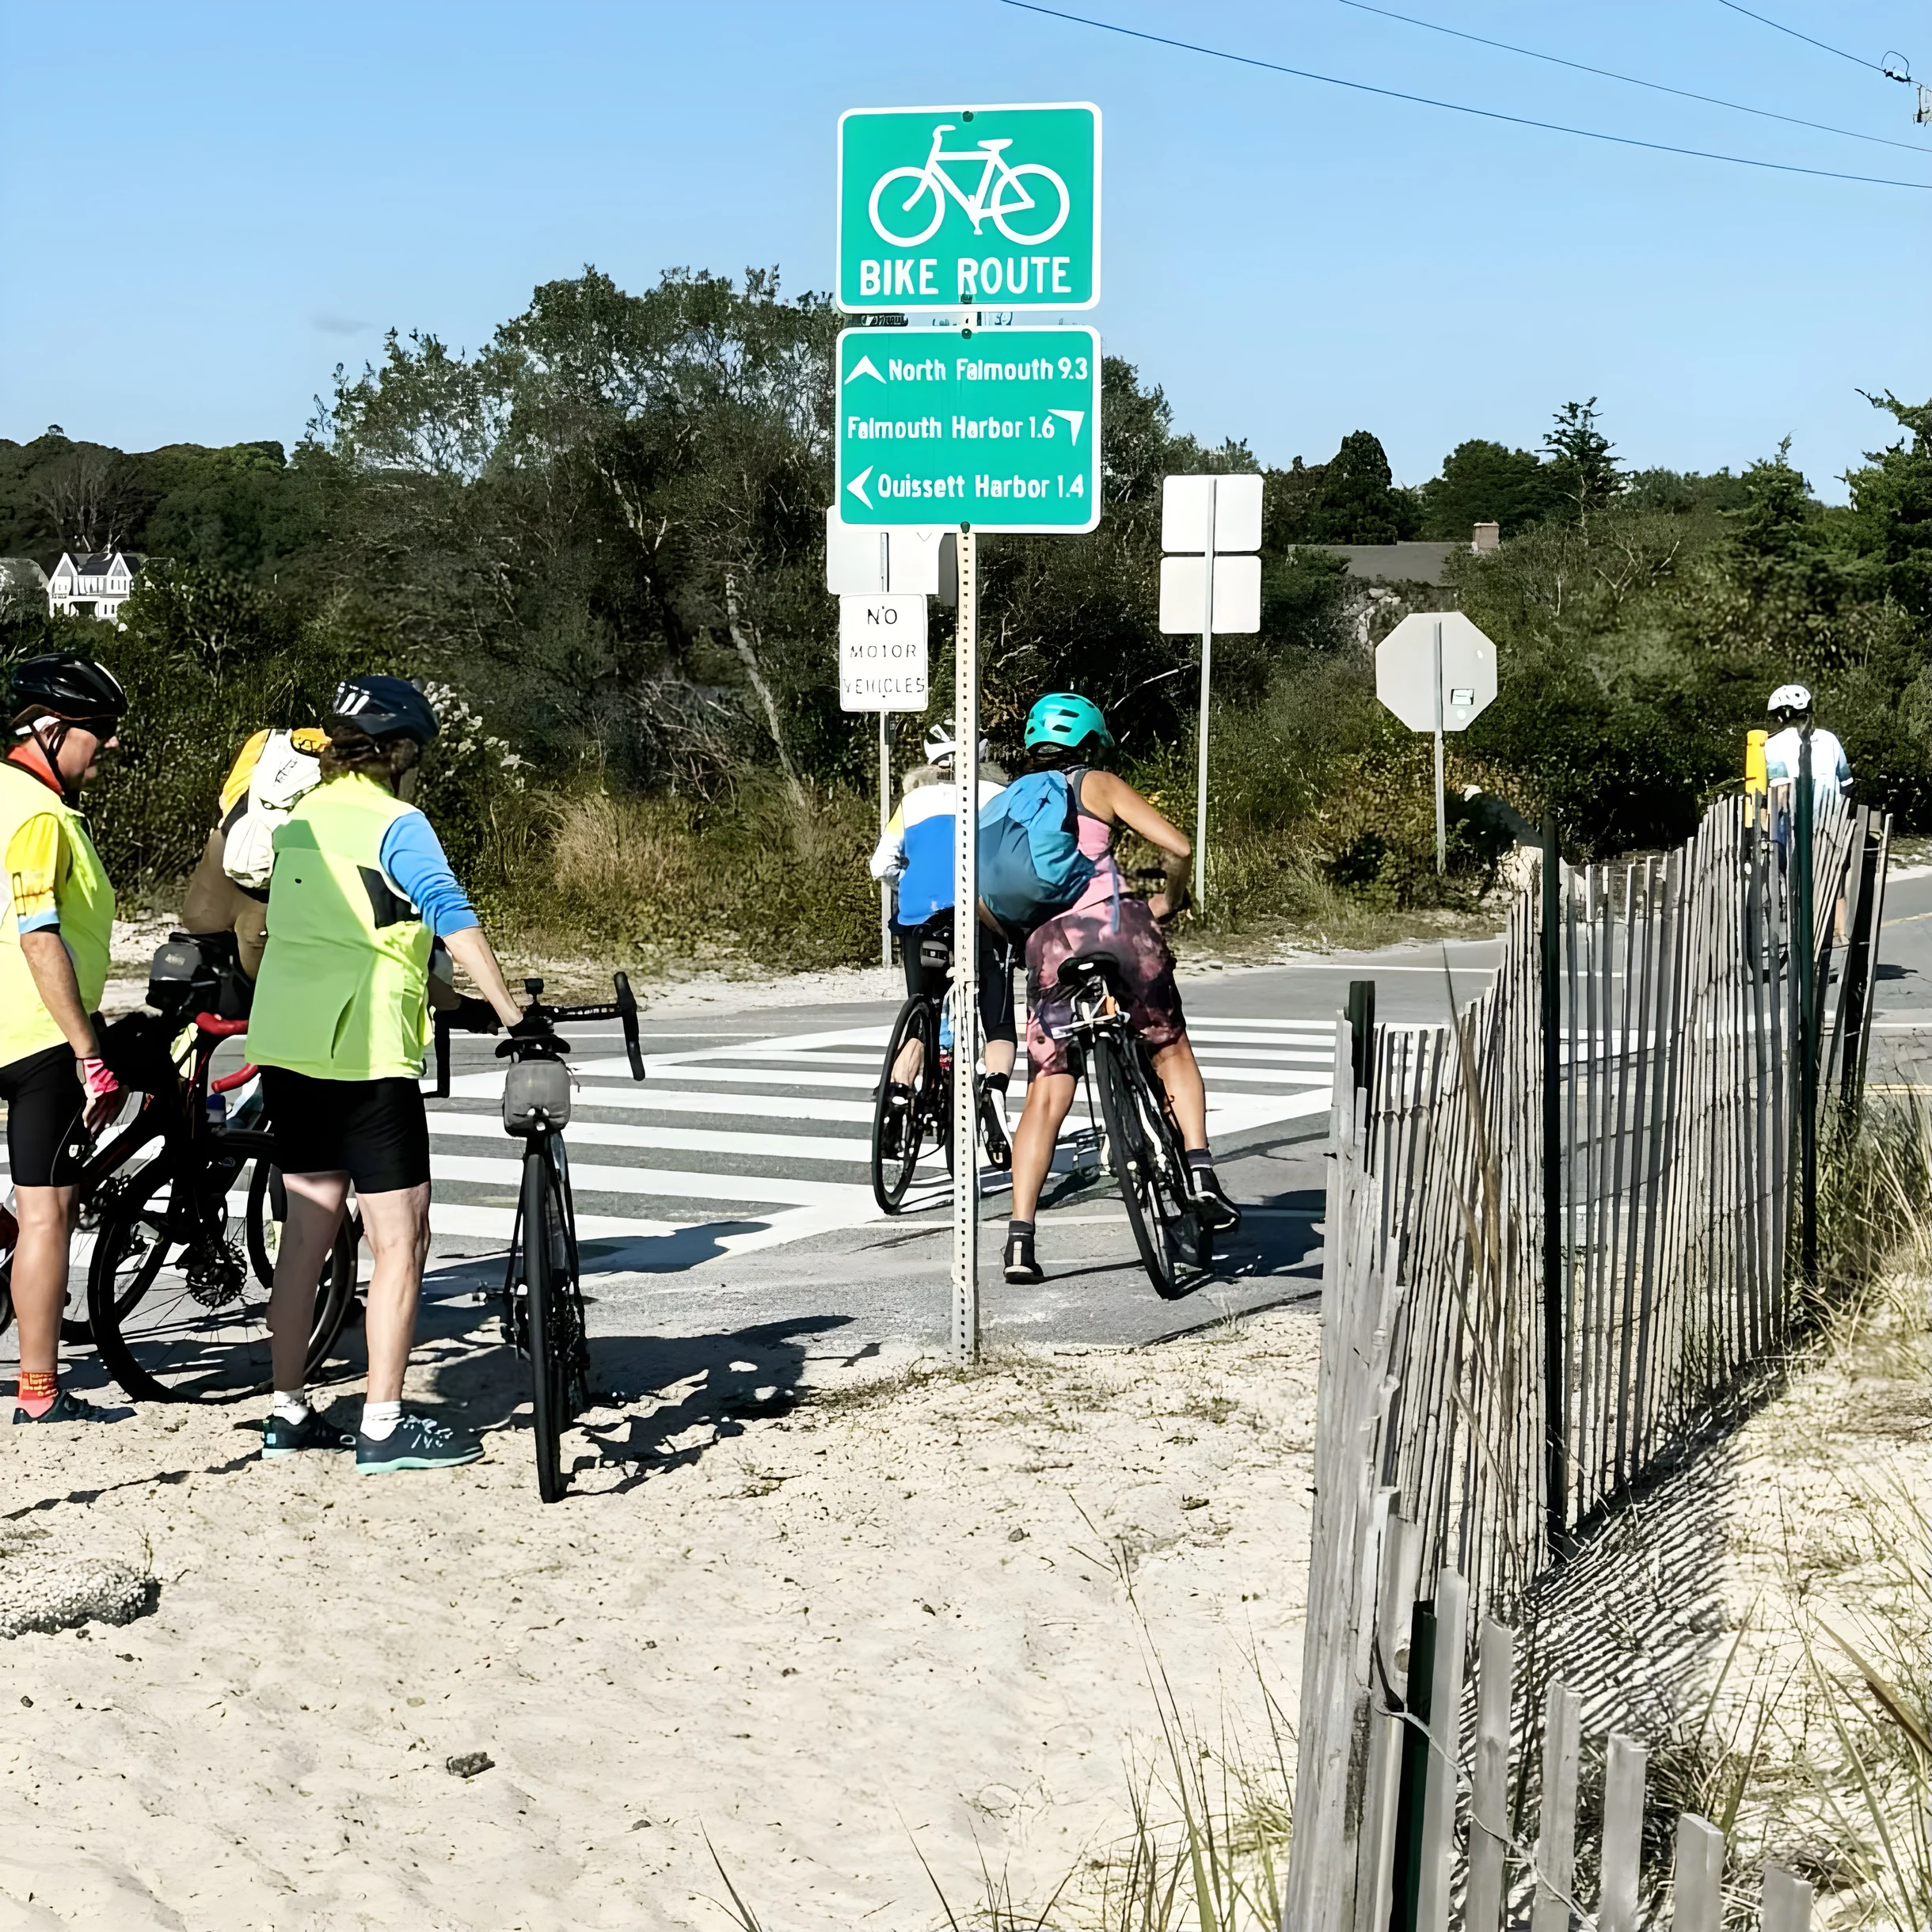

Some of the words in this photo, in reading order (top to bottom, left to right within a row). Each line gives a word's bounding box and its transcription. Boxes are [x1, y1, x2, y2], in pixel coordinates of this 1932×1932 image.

[860, 259, 939, 296] BIKE
[957, 257, 1072, 295] ROUTE
[888, 359, 946, 381] North
[956, 358, 1054, 380] Falmouth
[1057, 356, 1088, 379] 9.3
[847, 416, 942, 439] Falmouth
[952, 415, 1024, 439] Harbor
[1029, 415, 1055, 439] 1.6
[975, 473, 1050, 498] Harbor
[1057, 473, 1084, 498] 1.4
[867, 608, 898, 625] NO
[850, 644, 917, 658] MOTOR
